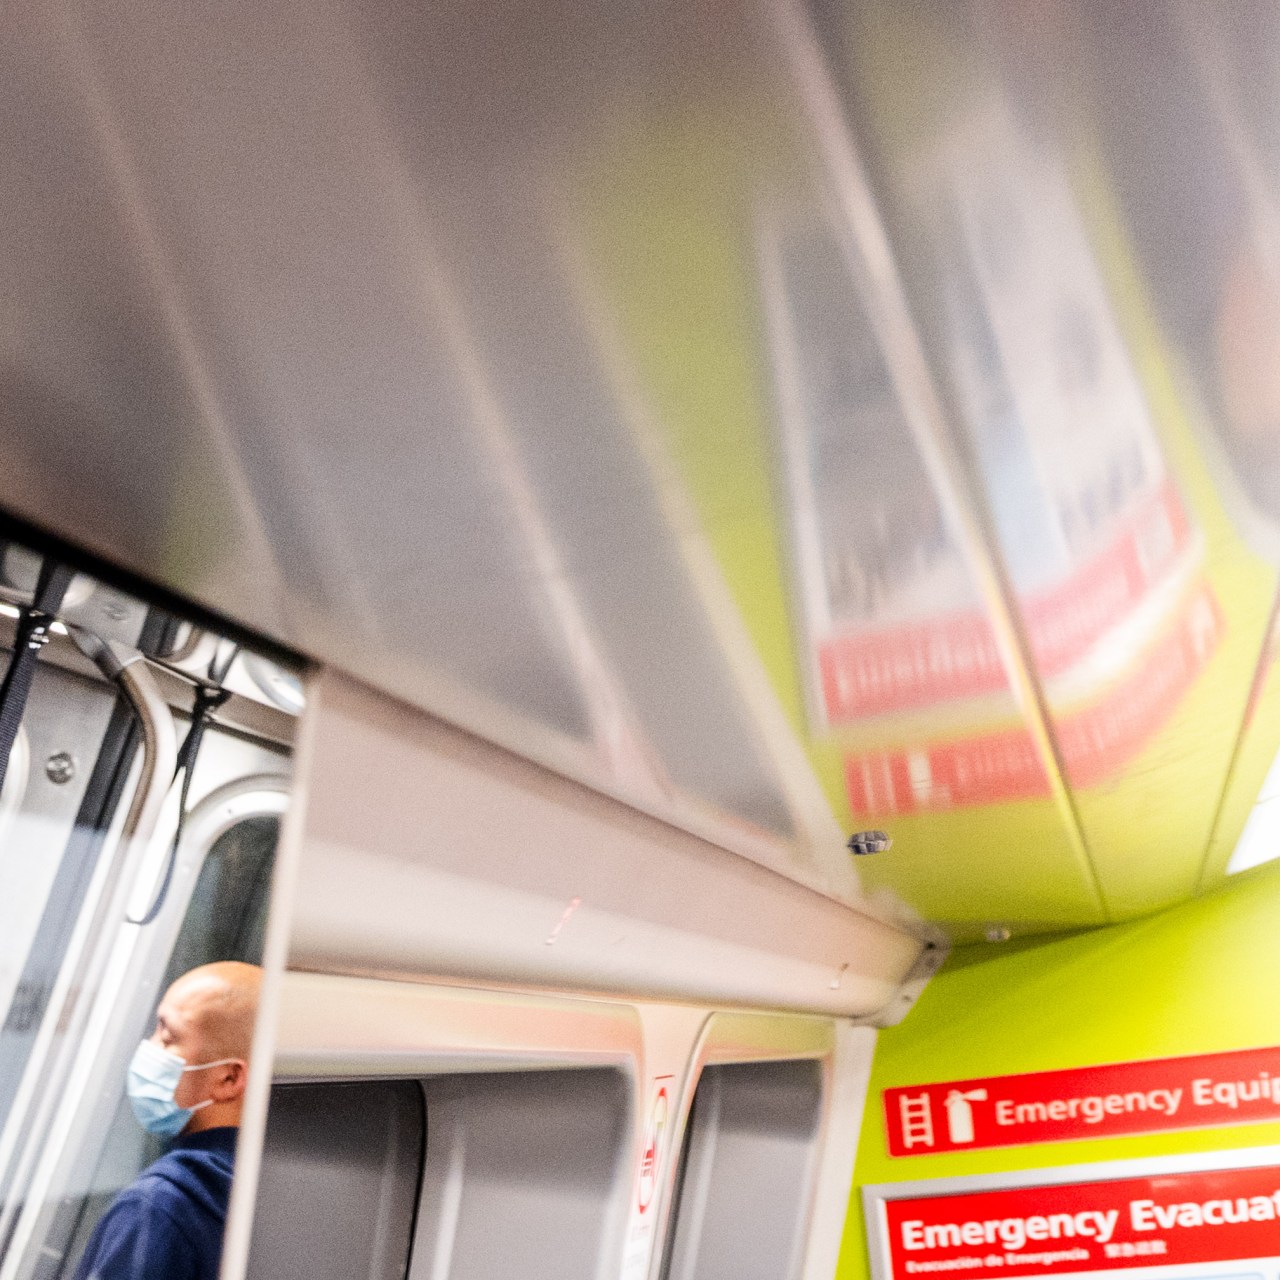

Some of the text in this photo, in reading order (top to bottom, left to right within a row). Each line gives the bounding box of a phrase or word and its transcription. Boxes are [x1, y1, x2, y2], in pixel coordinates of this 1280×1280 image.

[995, 1088, 1182, 1126] Emergency
[901, 1210, 1118, 1252] Emergency
[1005, 1248, 1090, 1266] Emergencia
